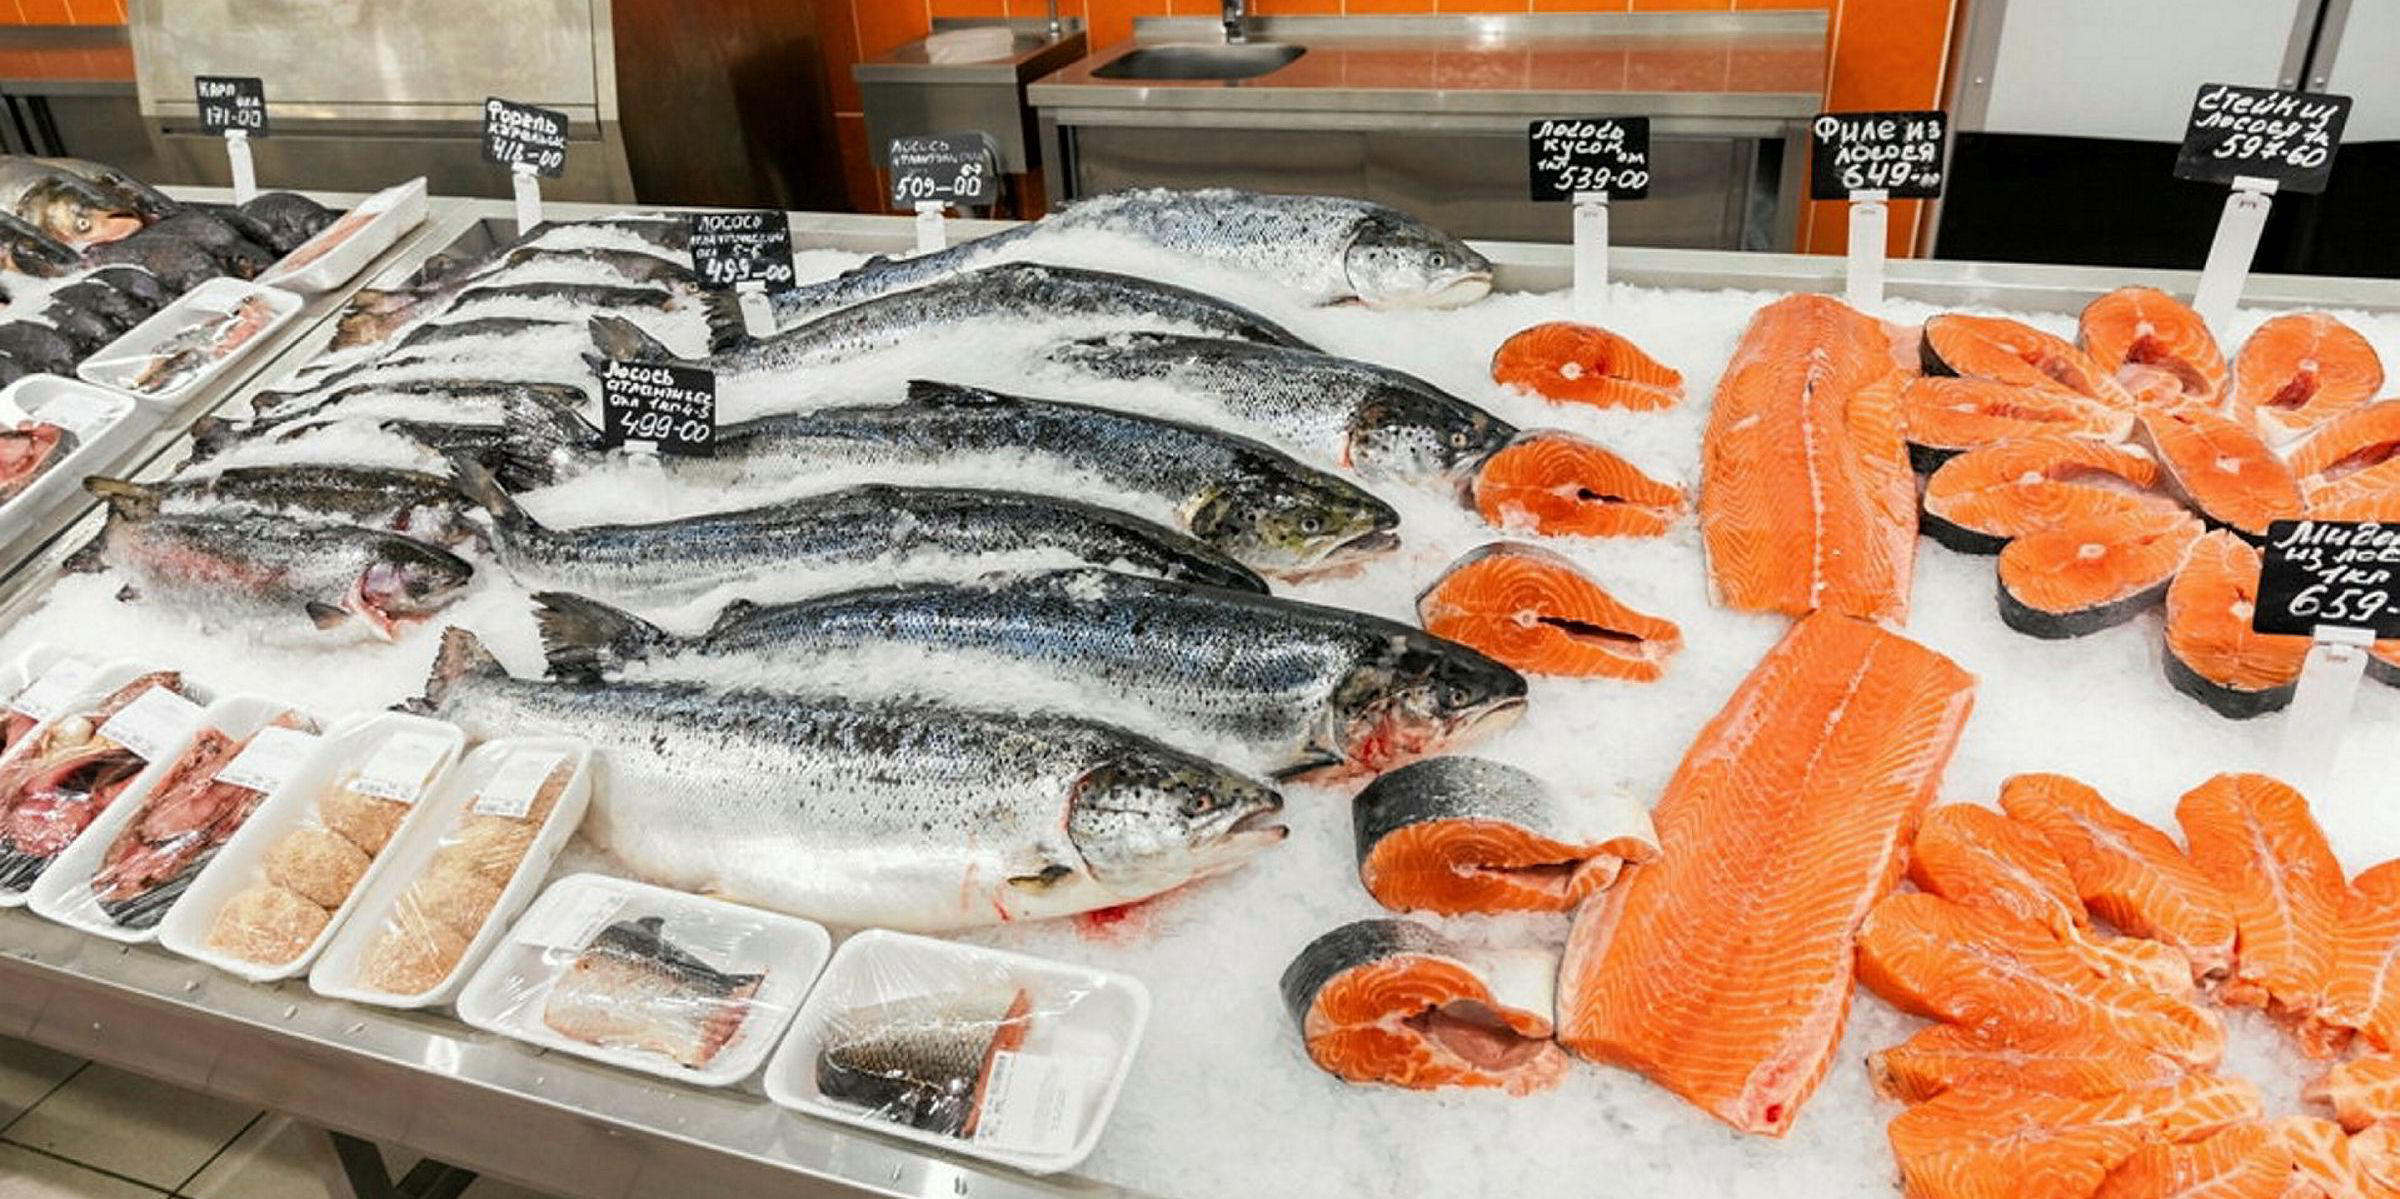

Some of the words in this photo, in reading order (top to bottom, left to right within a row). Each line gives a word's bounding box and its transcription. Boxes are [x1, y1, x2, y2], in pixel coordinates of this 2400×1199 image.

[895, 175, 982, 201] 509-00
[1553, 165, 1649, 190] 539-00
[705, 258, 792, 283] 499-00
[620, 411, 710, 443] 499-00
